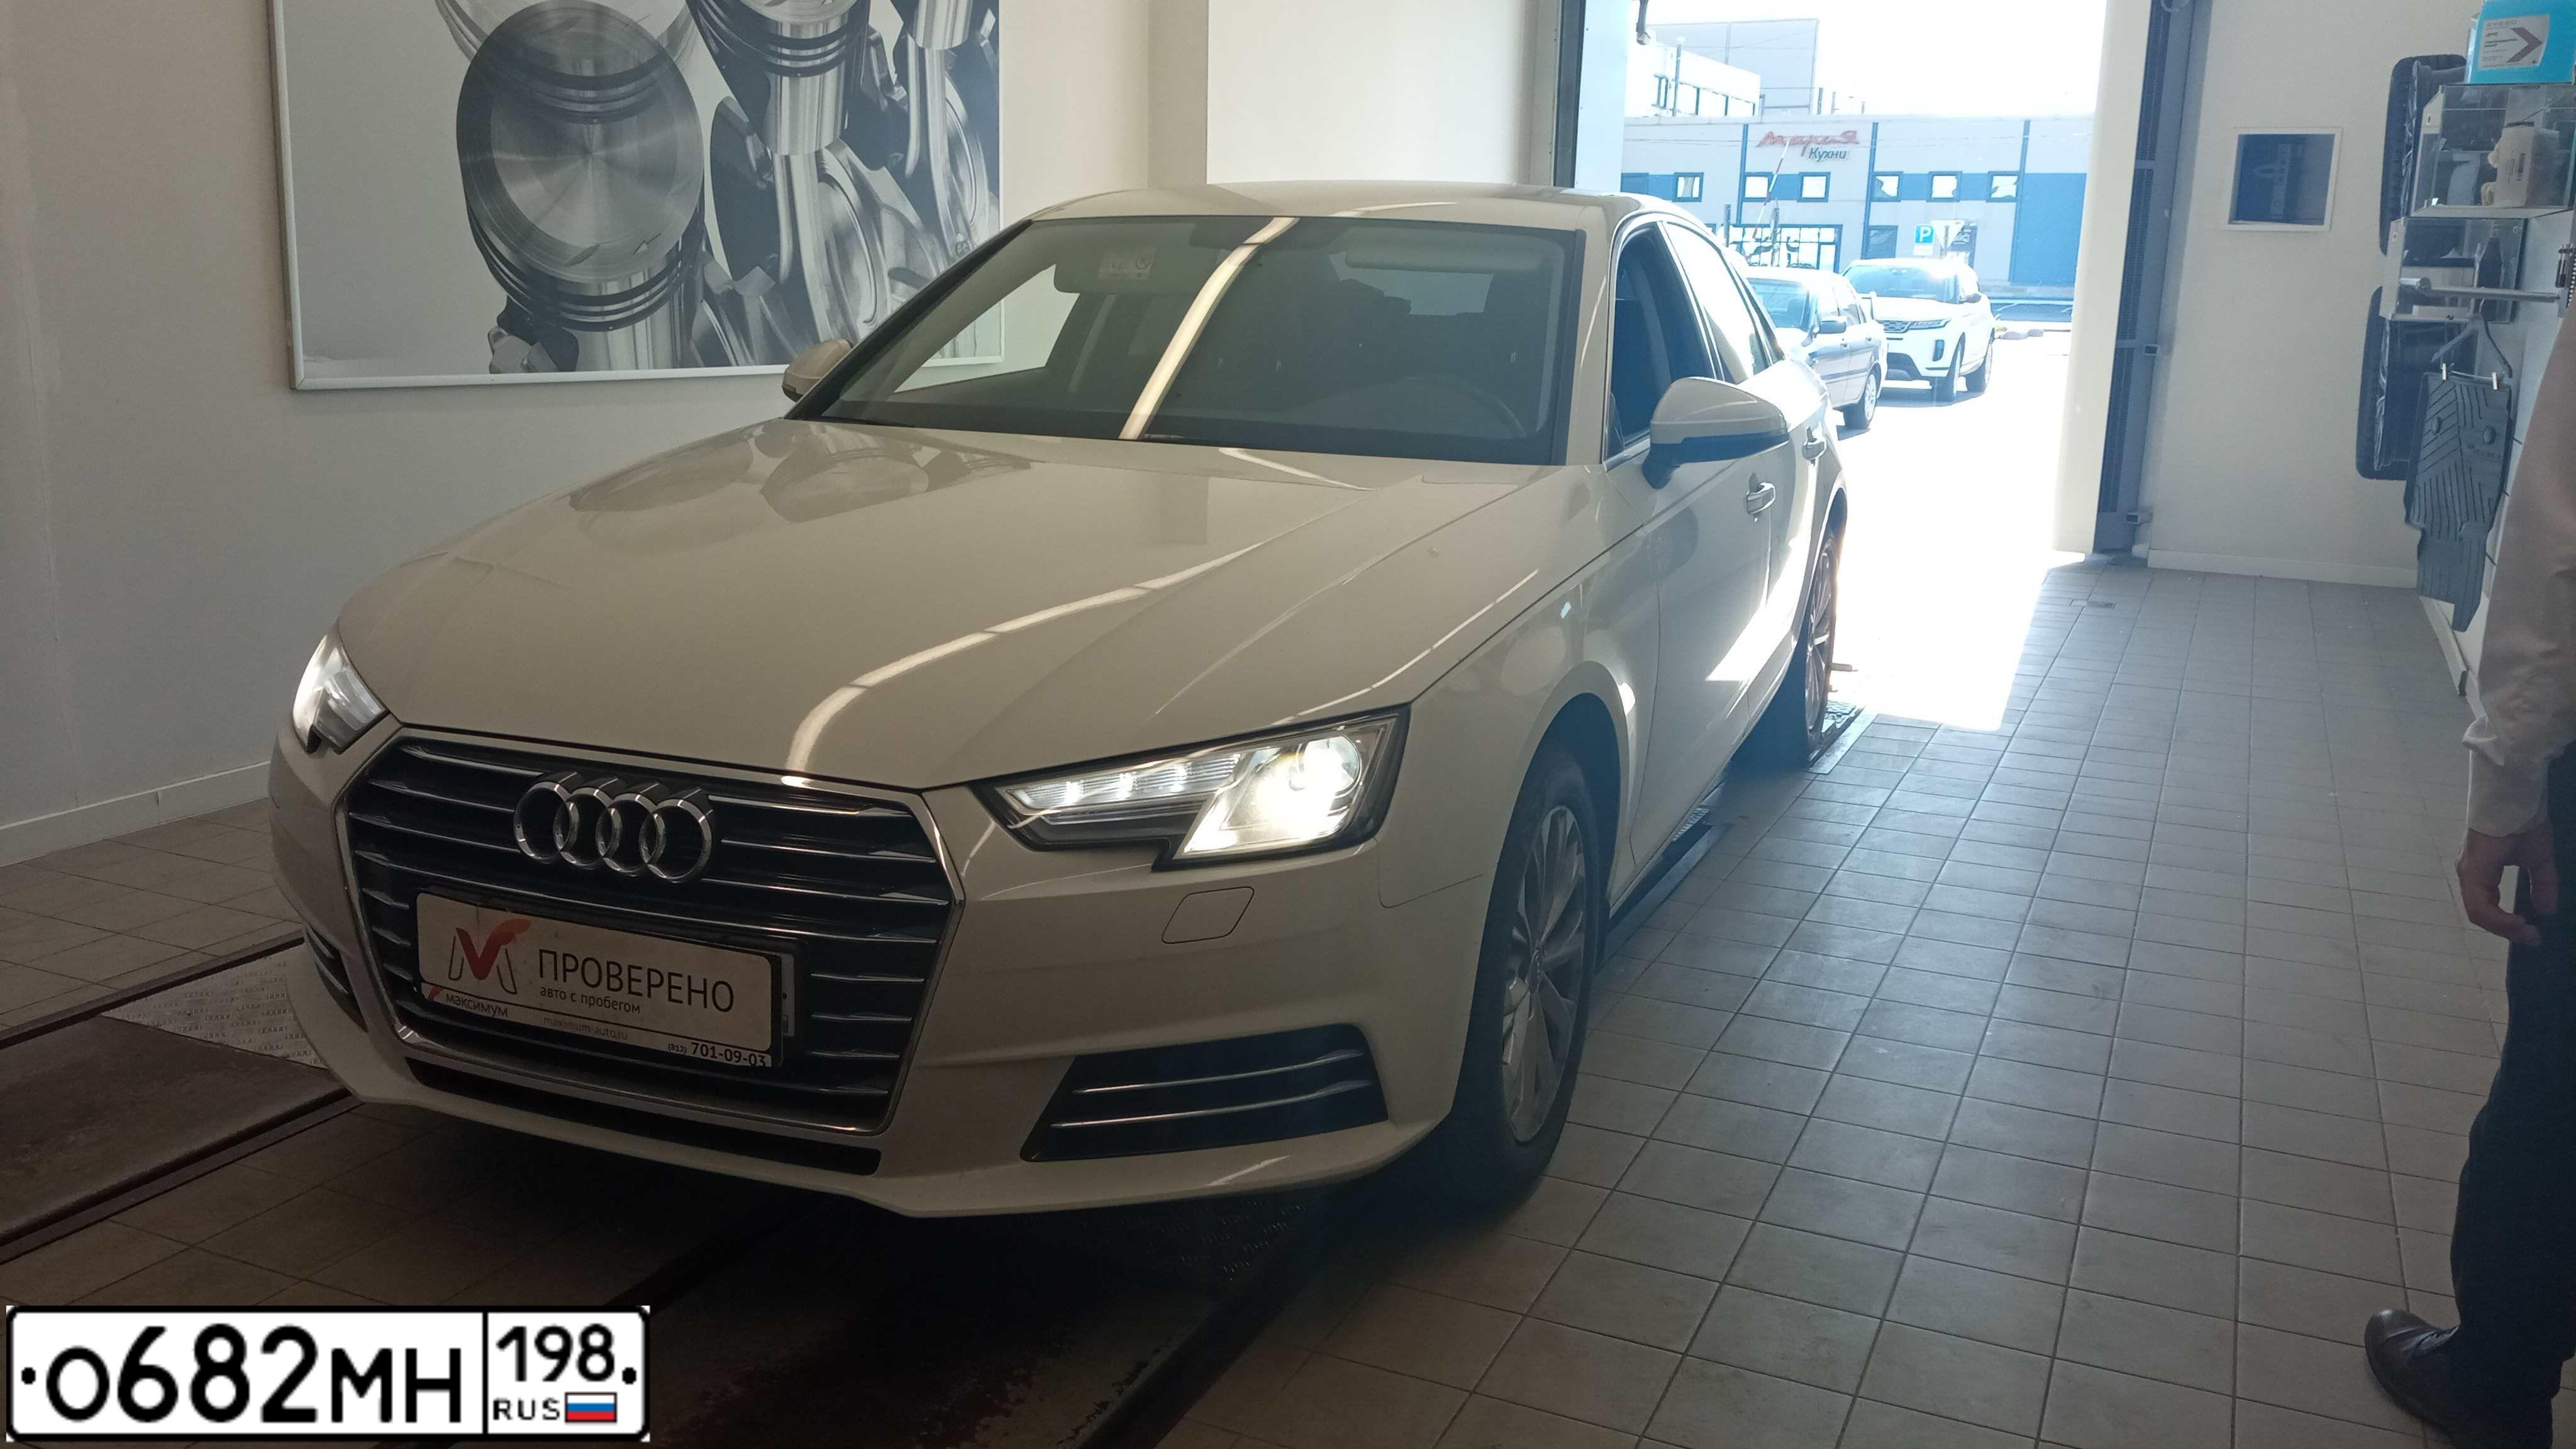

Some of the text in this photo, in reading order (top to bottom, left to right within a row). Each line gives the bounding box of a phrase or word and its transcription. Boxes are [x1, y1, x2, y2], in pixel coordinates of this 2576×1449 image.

[1808, 147, 1847, 162] Кухни
[1919, 226, 1933, 243] P
[539, 949, 734, 1013] ПРОВЕРЕНО
[445, 992, 508, 1017] максимум
[540, 986, 640, 1014] авто с пробегом
[544, 1017, 628, 1040] maximum-auto.ru
[669, 1042, 766, 1067] (812) 701-09-03
